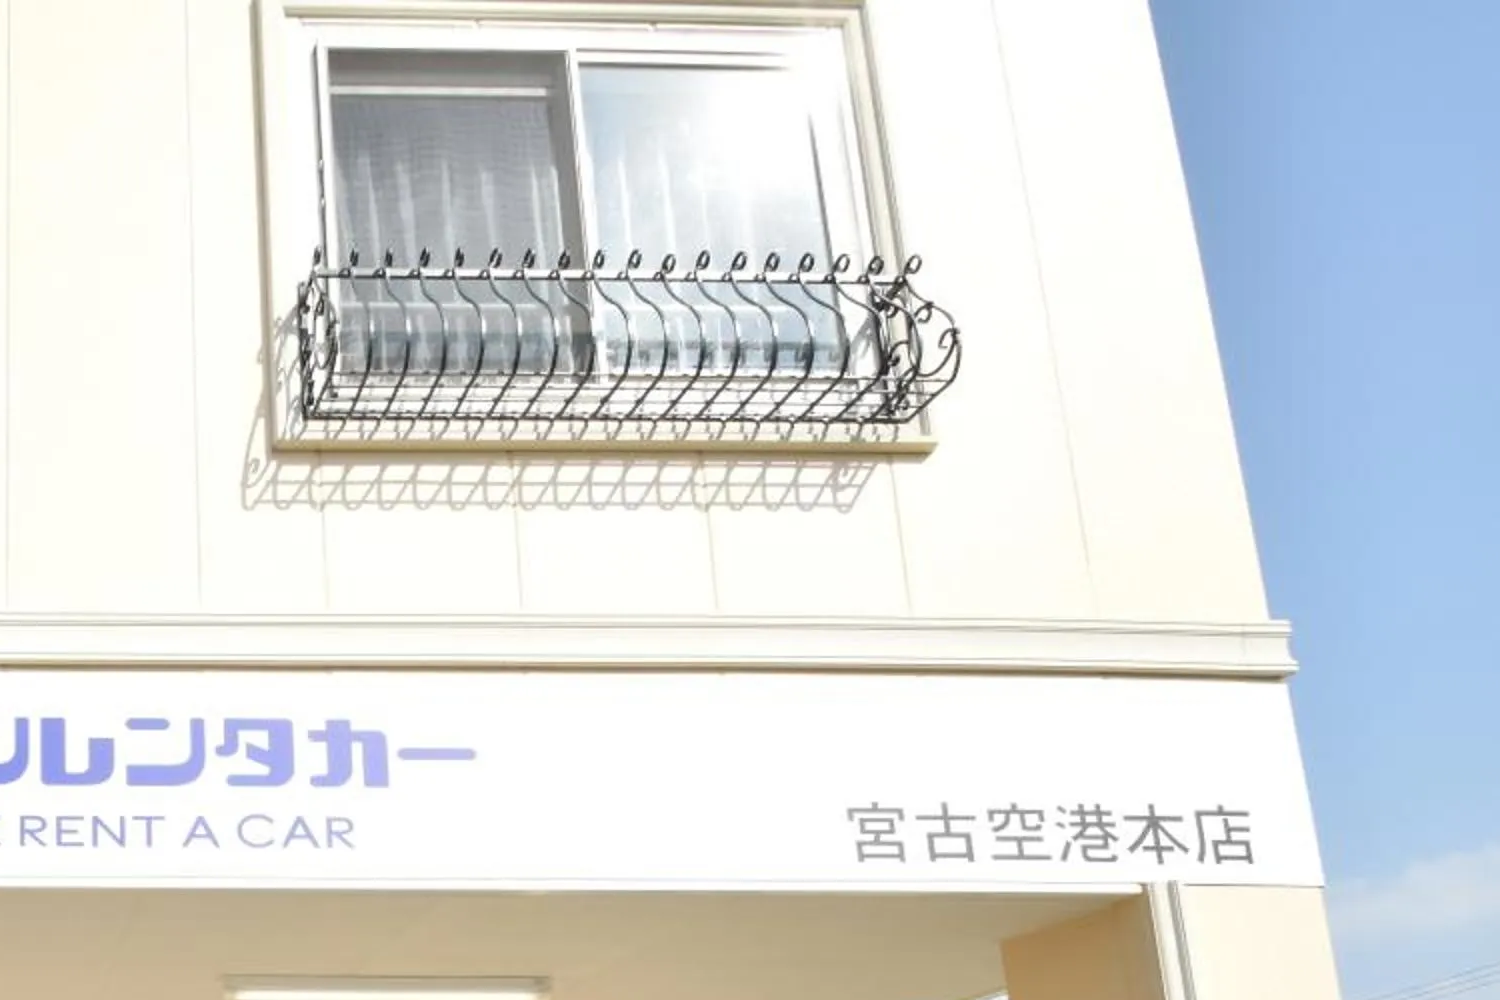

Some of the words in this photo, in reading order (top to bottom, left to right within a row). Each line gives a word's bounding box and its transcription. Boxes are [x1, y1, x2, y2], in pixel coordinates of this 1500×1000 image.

[19, 814, 165, 849] RENT
[182, 815, 221, 849] A
[236, 813, 356, 850] CAR
[846, 801, 1255, 865] 宮古空港本店
